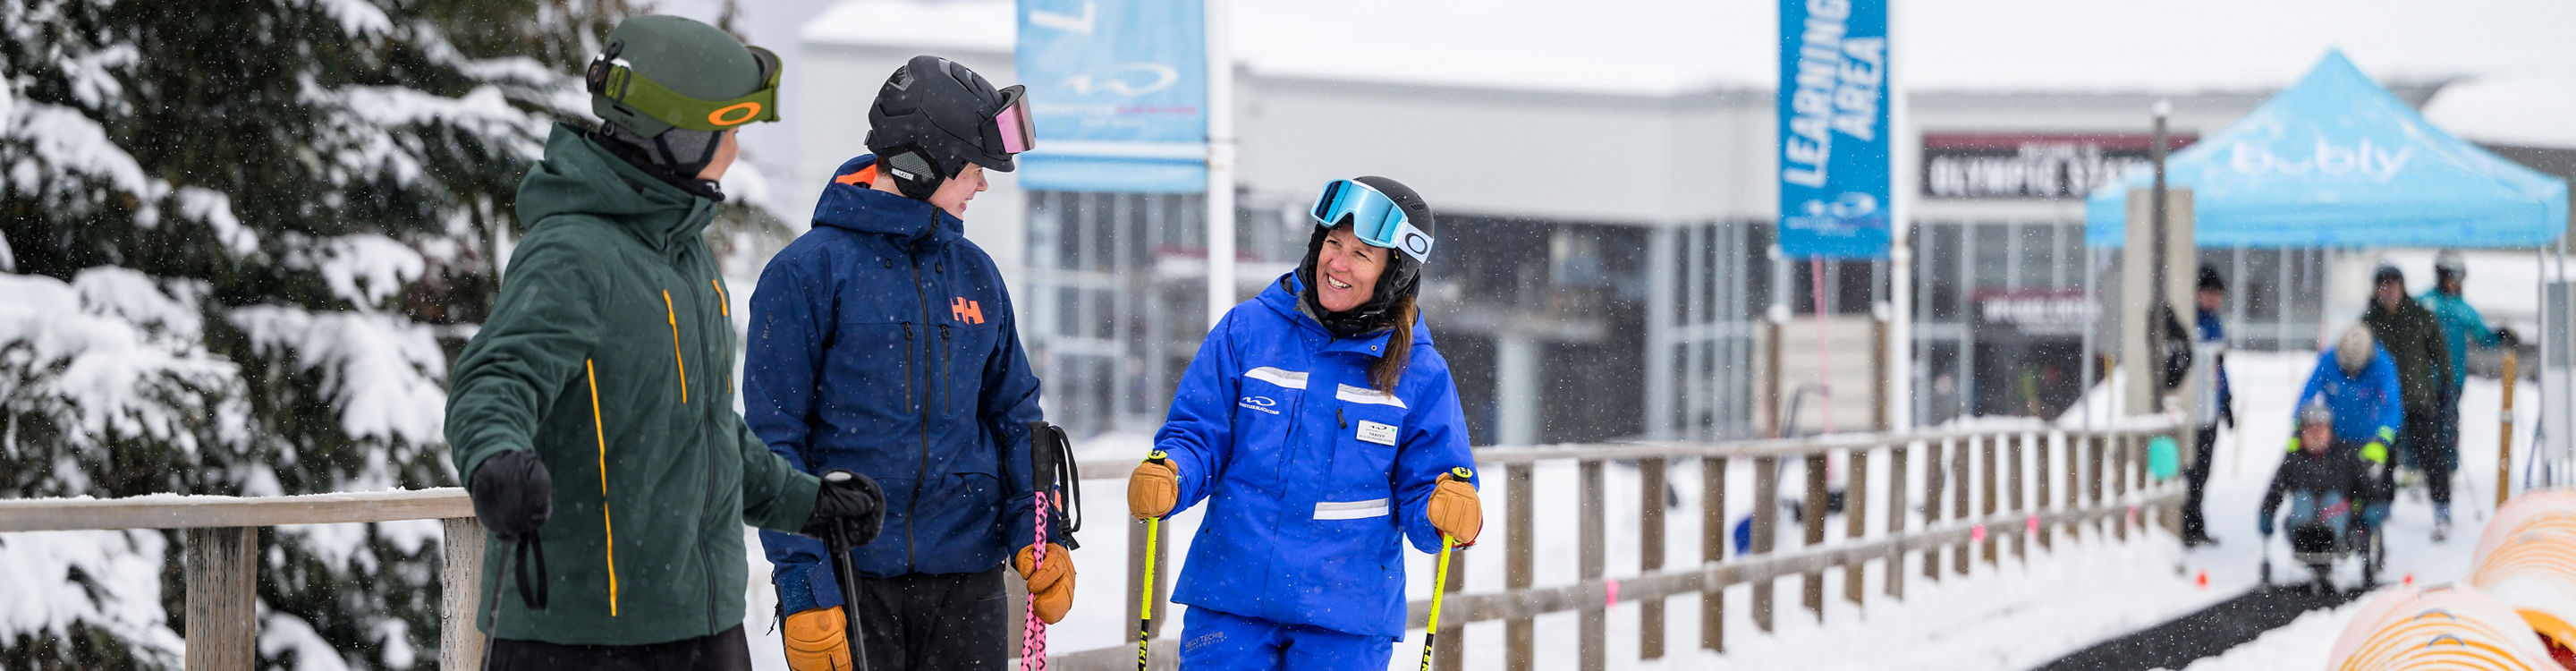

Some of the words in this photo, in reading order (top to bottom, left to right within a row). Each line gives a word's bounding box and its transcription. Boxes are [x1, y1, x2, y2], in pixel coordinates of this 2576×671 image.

[1783, 0, 1852, 189] LEARNING
[1830, 36, 1885, 142] AREA
[1928, 156, 2056, 198] OLYMPIC
[1139, 631, 1148, 664] LEKI
